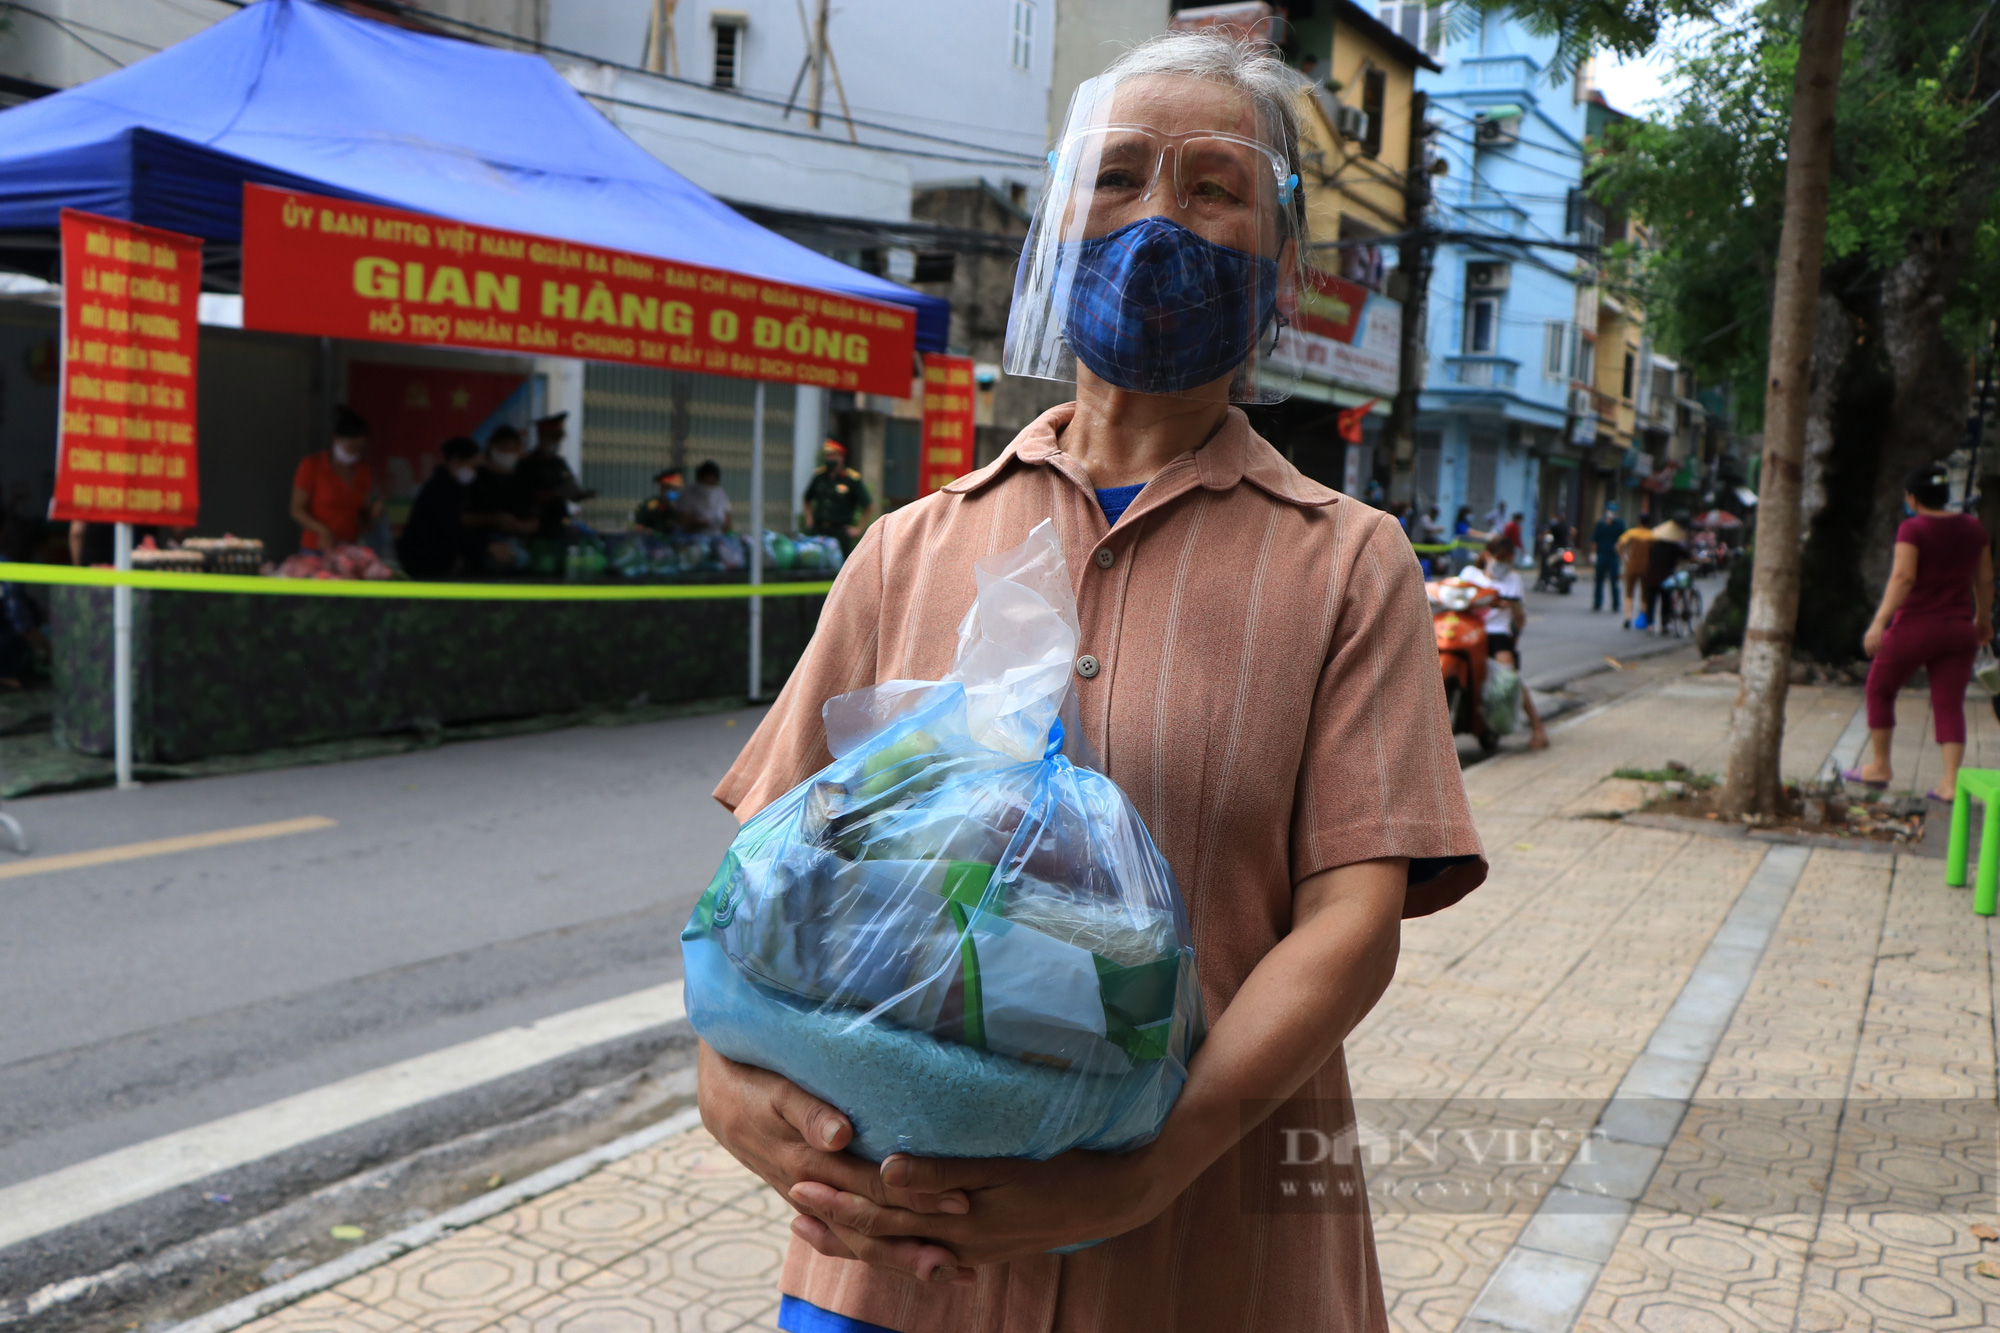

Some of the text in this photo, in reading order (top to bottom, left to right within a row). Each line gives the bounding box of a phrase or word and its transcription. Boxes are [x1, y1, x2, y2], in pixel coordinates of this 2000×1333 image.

[282, 196, 313, 228] ỦY
[320, 209, 367, 237] BAN
[436, 224, 475, 257] VIỆT
[480, 235, 525, 259] NAM
[529, 242, 582, 273] QUẬN
[586, 252, 609, 273] BA
[665, 267, 697, 290] BAN
[353, 256, 520, 313] GIAN
[541, 280, 694, 336] HÀNG
[752, 314, 870, 365] ĐỒNG
[368, 302, 405, 334] HỖ
[409, 313, 451, 342] TRỢ
[454, 316, 513, 343] NHÂN
[516, 321, 558, 347] DÂN
[571, 331, 636, 358] CHUNG
[639, 339, 666, 361] TAY
